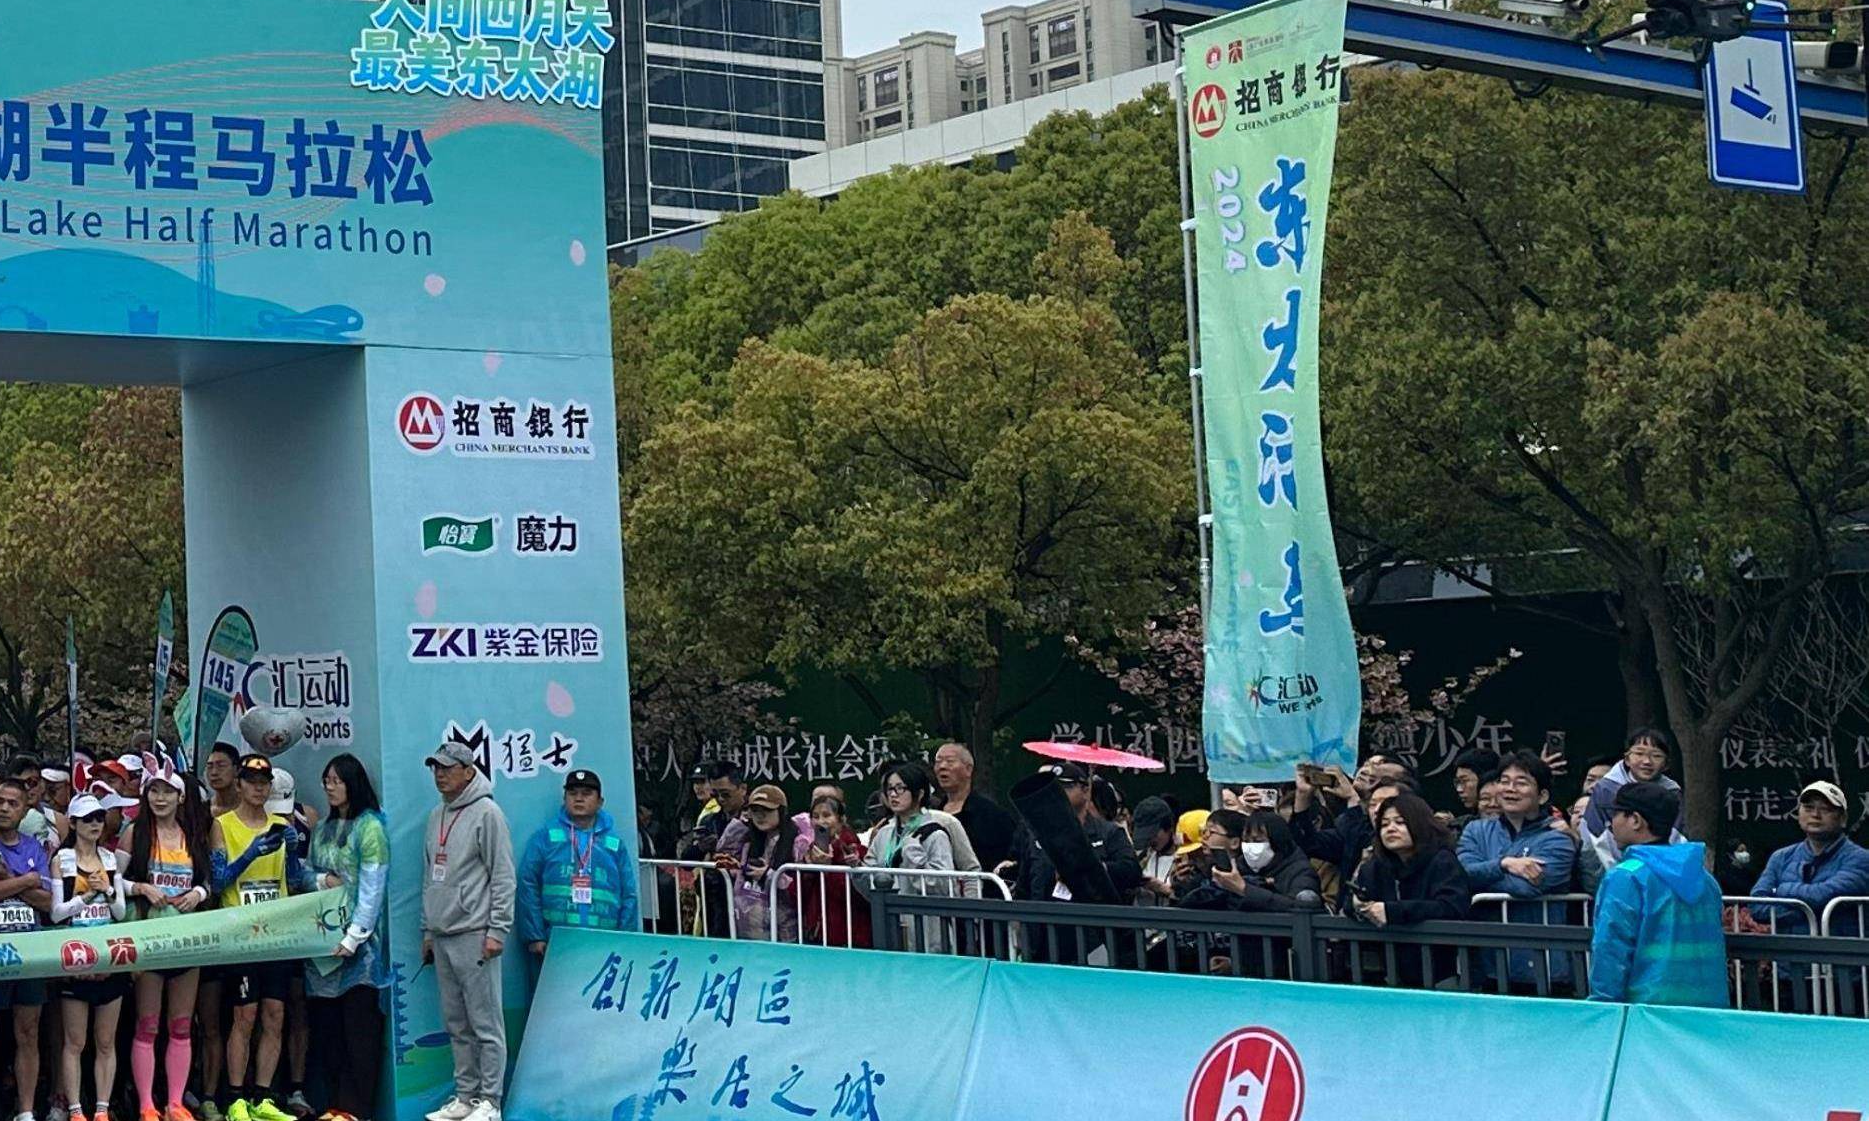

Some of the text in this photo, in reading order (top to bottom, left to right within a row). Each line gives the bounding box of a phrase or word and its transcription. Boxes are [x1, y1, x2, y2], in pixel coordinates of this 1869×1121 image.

[350, 28, 605, 110] 最美东太湖
[0, 198, 104, 240] Lake
[125, 205, 216, 244] Half
[233, 212, 433, 257] Marathon
[452, 399, 590, 439] 招商銀行
[454, 442, 591, 456] CHINA MERCHANTS BANK
[516, 515, 578, 553] 魔力
[411, 627, 599, 658] ZKI 紫金保险
[208, 657, 235, 694] 145
[271, 656, 351, 710] 汇运动
[303, 717, 352, 744] Sports
